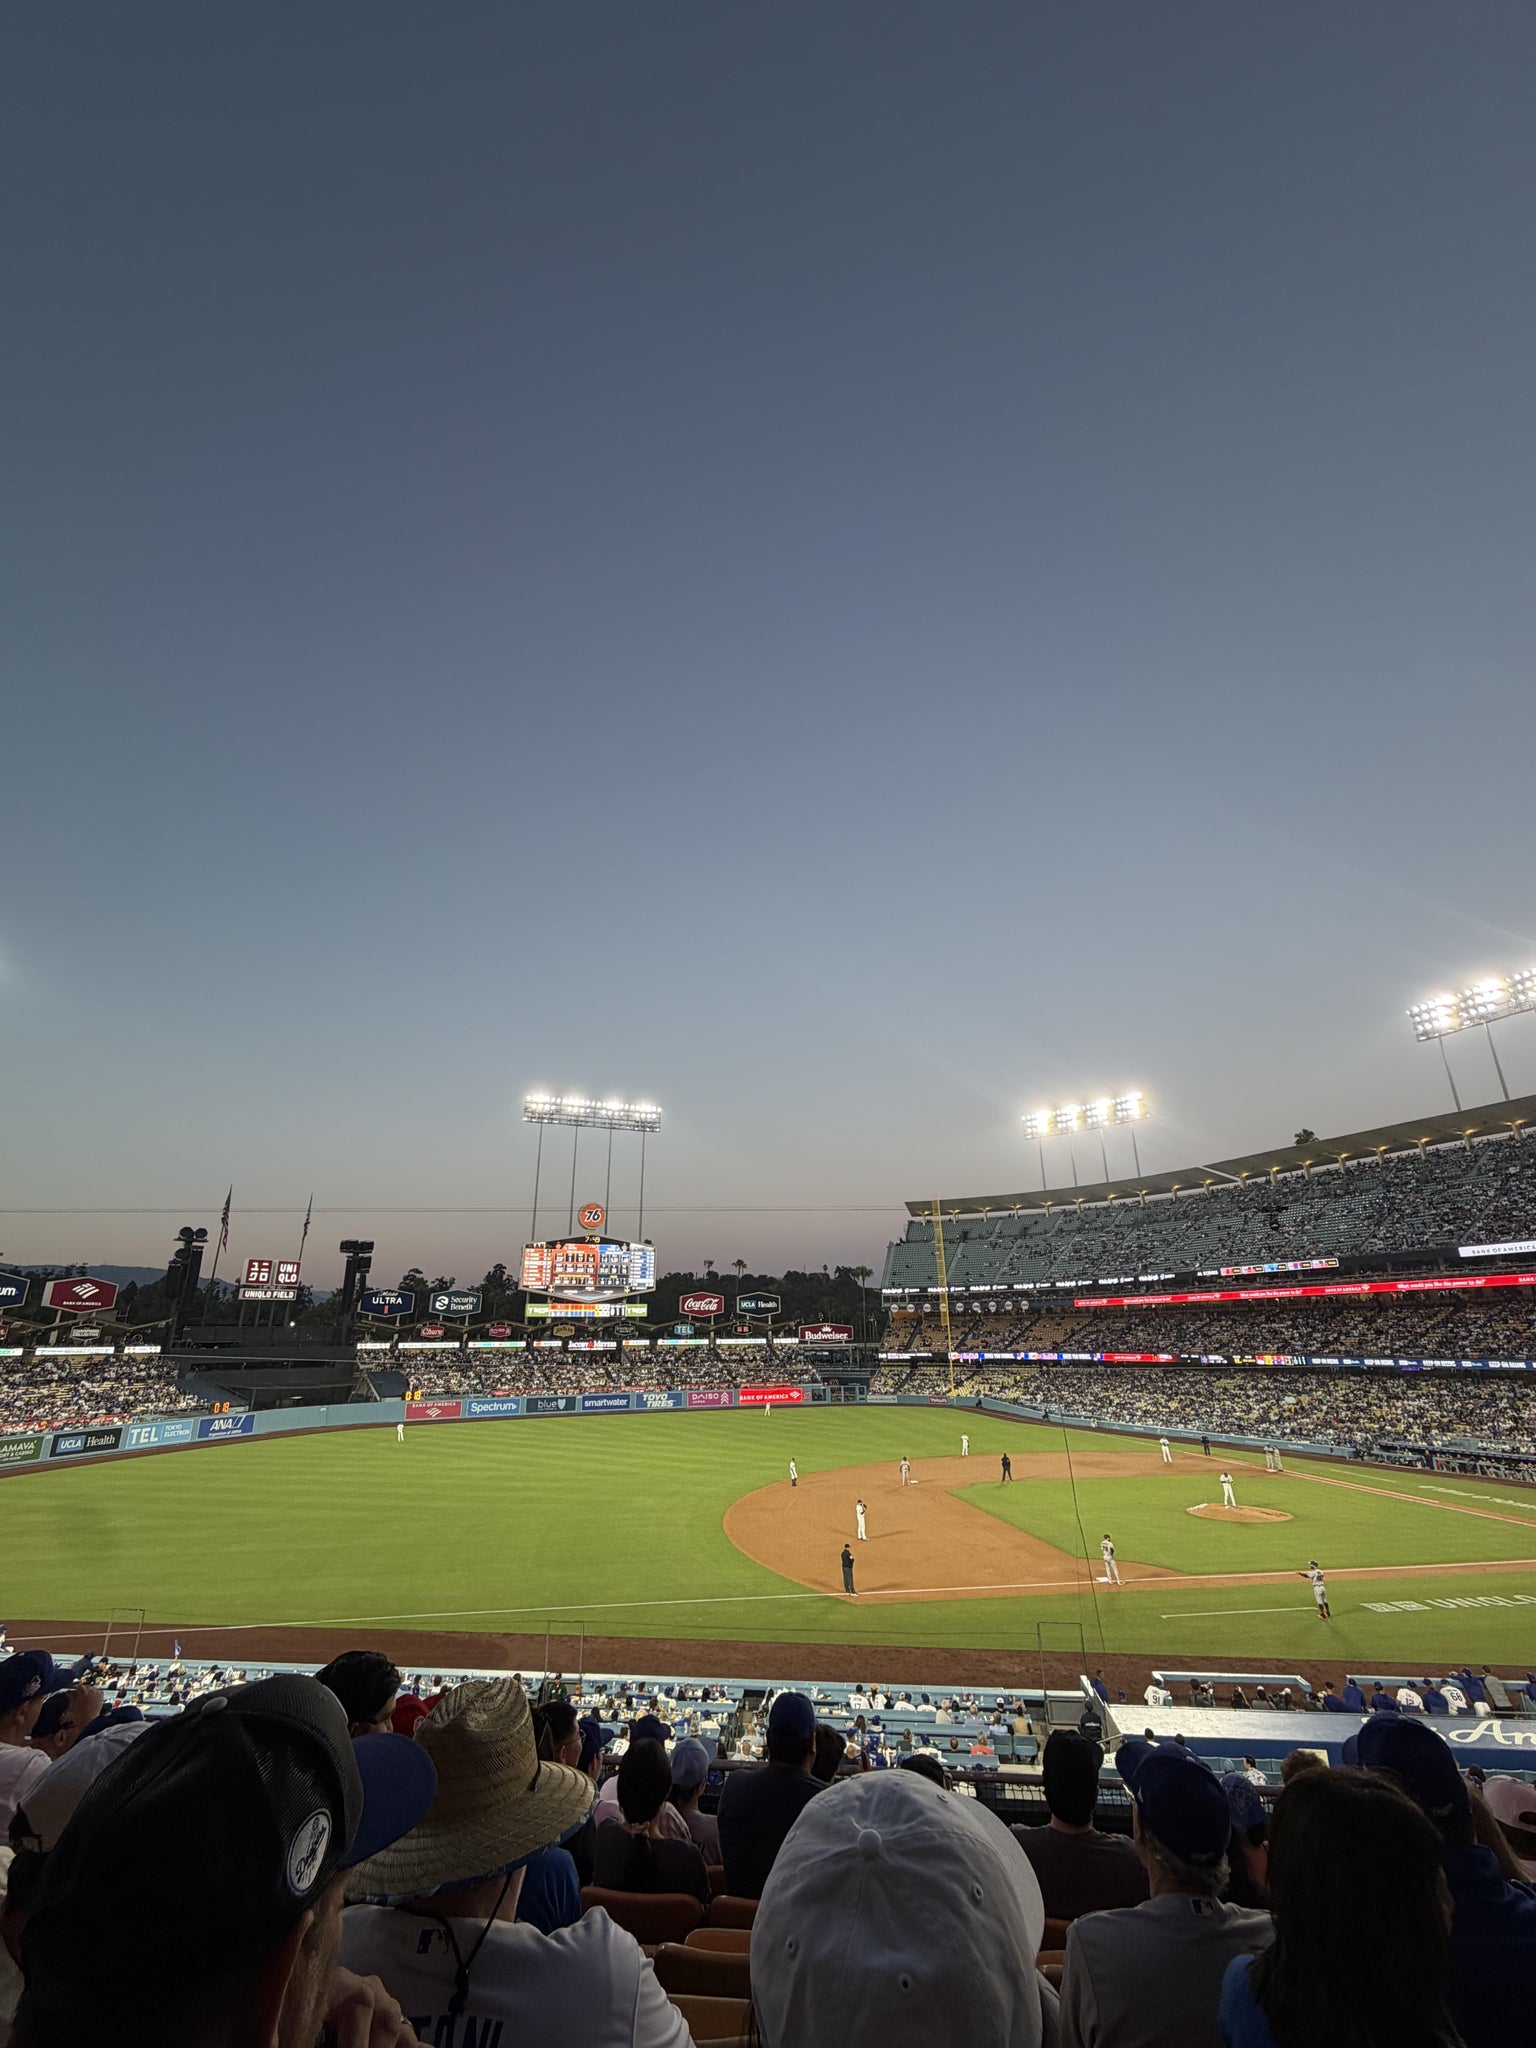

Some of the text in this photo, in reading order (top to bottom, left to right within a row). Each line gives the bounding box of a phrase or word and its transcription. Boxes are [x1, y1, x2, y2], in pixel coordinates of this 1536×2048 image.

[584, 1209, 601, 1222] 76
[280, 1264, 297, 1273] UNI
[278, 1274, 297, 1283] QLO
[244, 1291, 272, 1299] UNIQLO
[372, 1296, 403, 1304] ULTRA
[450, 1296, 478, 1304] Security
[684, 1297, 719, 1311] Coca-Cola
[758, 1300, 778, 1308] Health
[450, 1303, 473, 1311] Benefit
[676, 1325, 691, 1334] TEL
[642, 1393, 668, 1401] TOYO
[692, 1393, 719, 1401] DAISO
[538, 1399, 557, 1408] blue
[584, 1398, 628, 1407] smartwater
[646, 1400, 674, 1408] TIRES
[470, 1402, 514, 1414] Spectrum
[210, 1418, 233, 1431] ANA
[131, 1427, 159, 1445] TEL
[164, 1429, 190, 1438] ELECTRON
[60, 1434, 116, 1449] UCLA Health
[1152, 1694, 1161, 1705] 91
